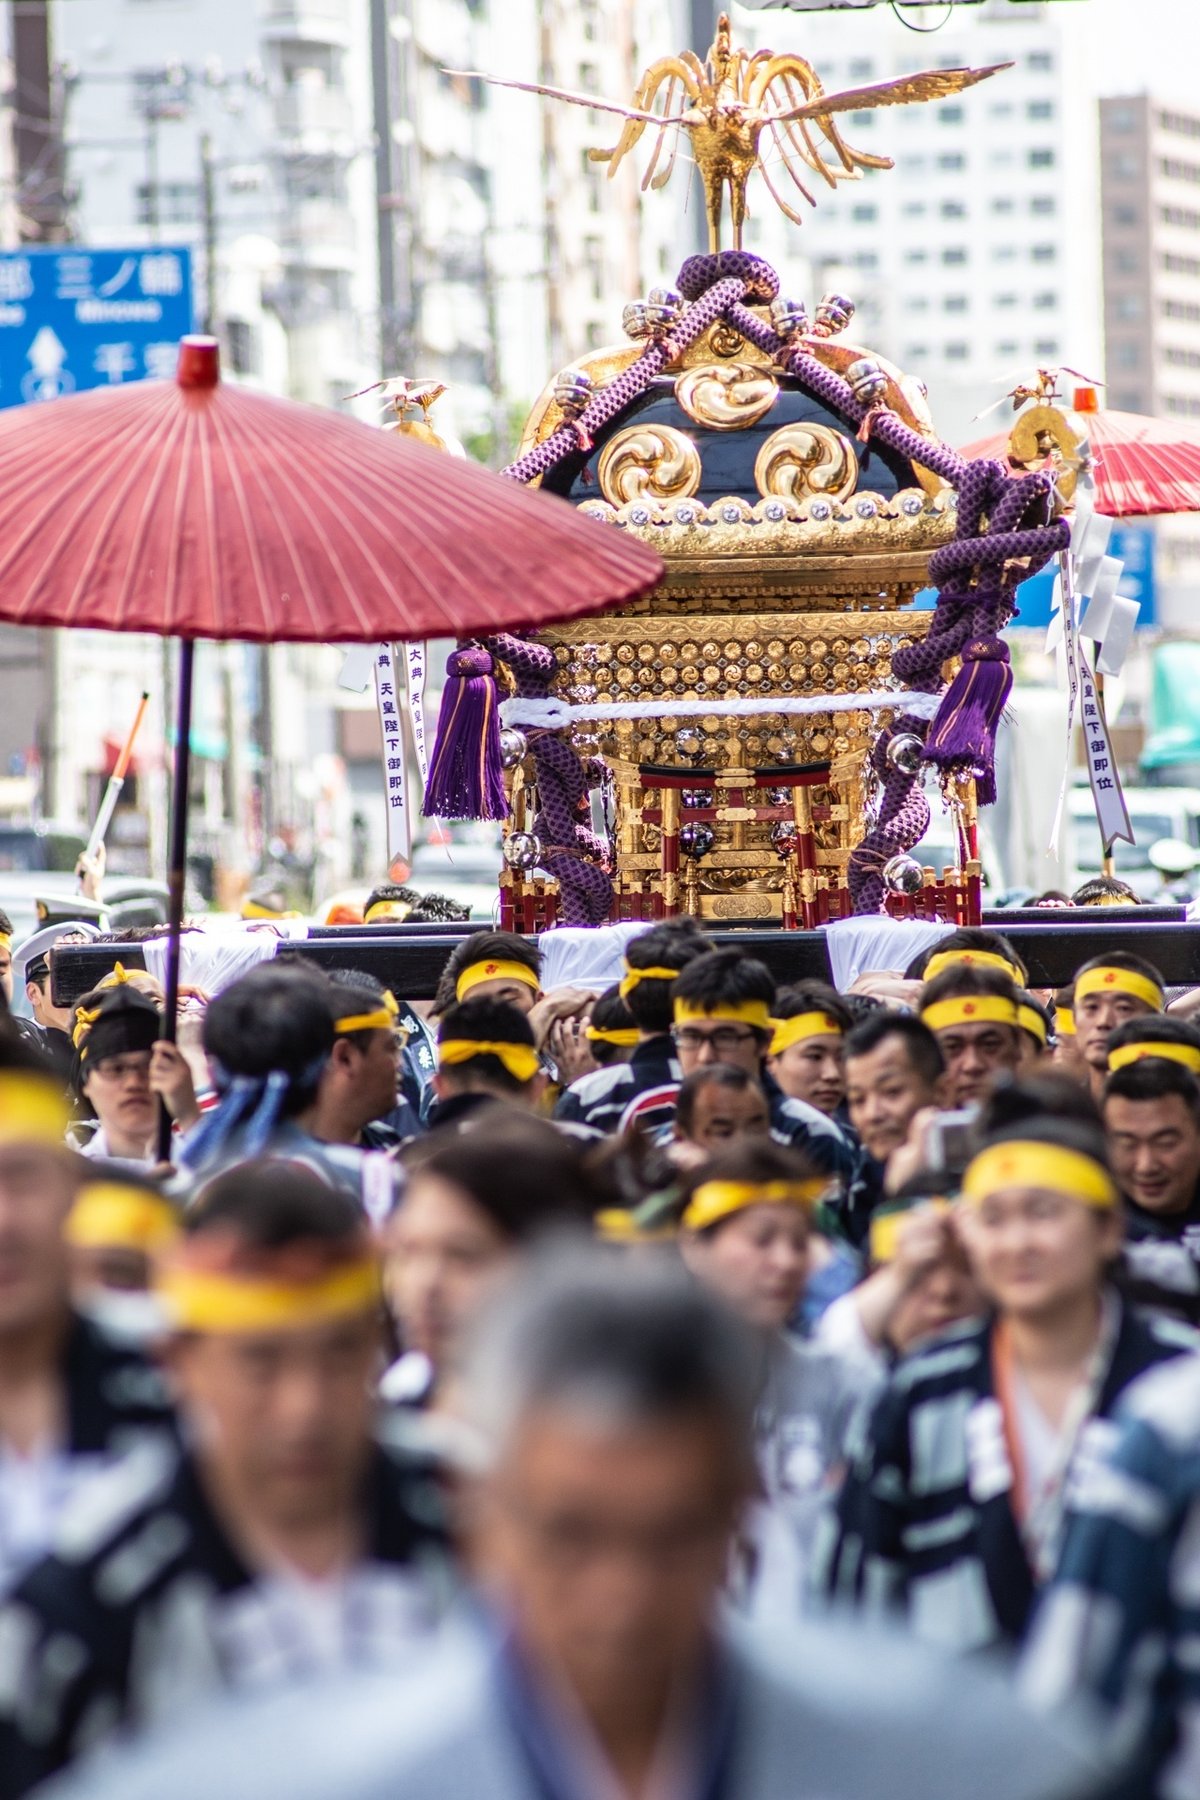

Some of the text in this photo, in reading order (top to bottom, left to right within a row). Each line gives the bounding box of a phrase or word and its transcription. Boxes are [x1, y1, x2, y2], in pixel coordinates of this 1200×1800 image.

[381, 682, 403, 808] 天皇陛下御即位
[1081, 667, 1114, 790] 天皇陛下御即位
